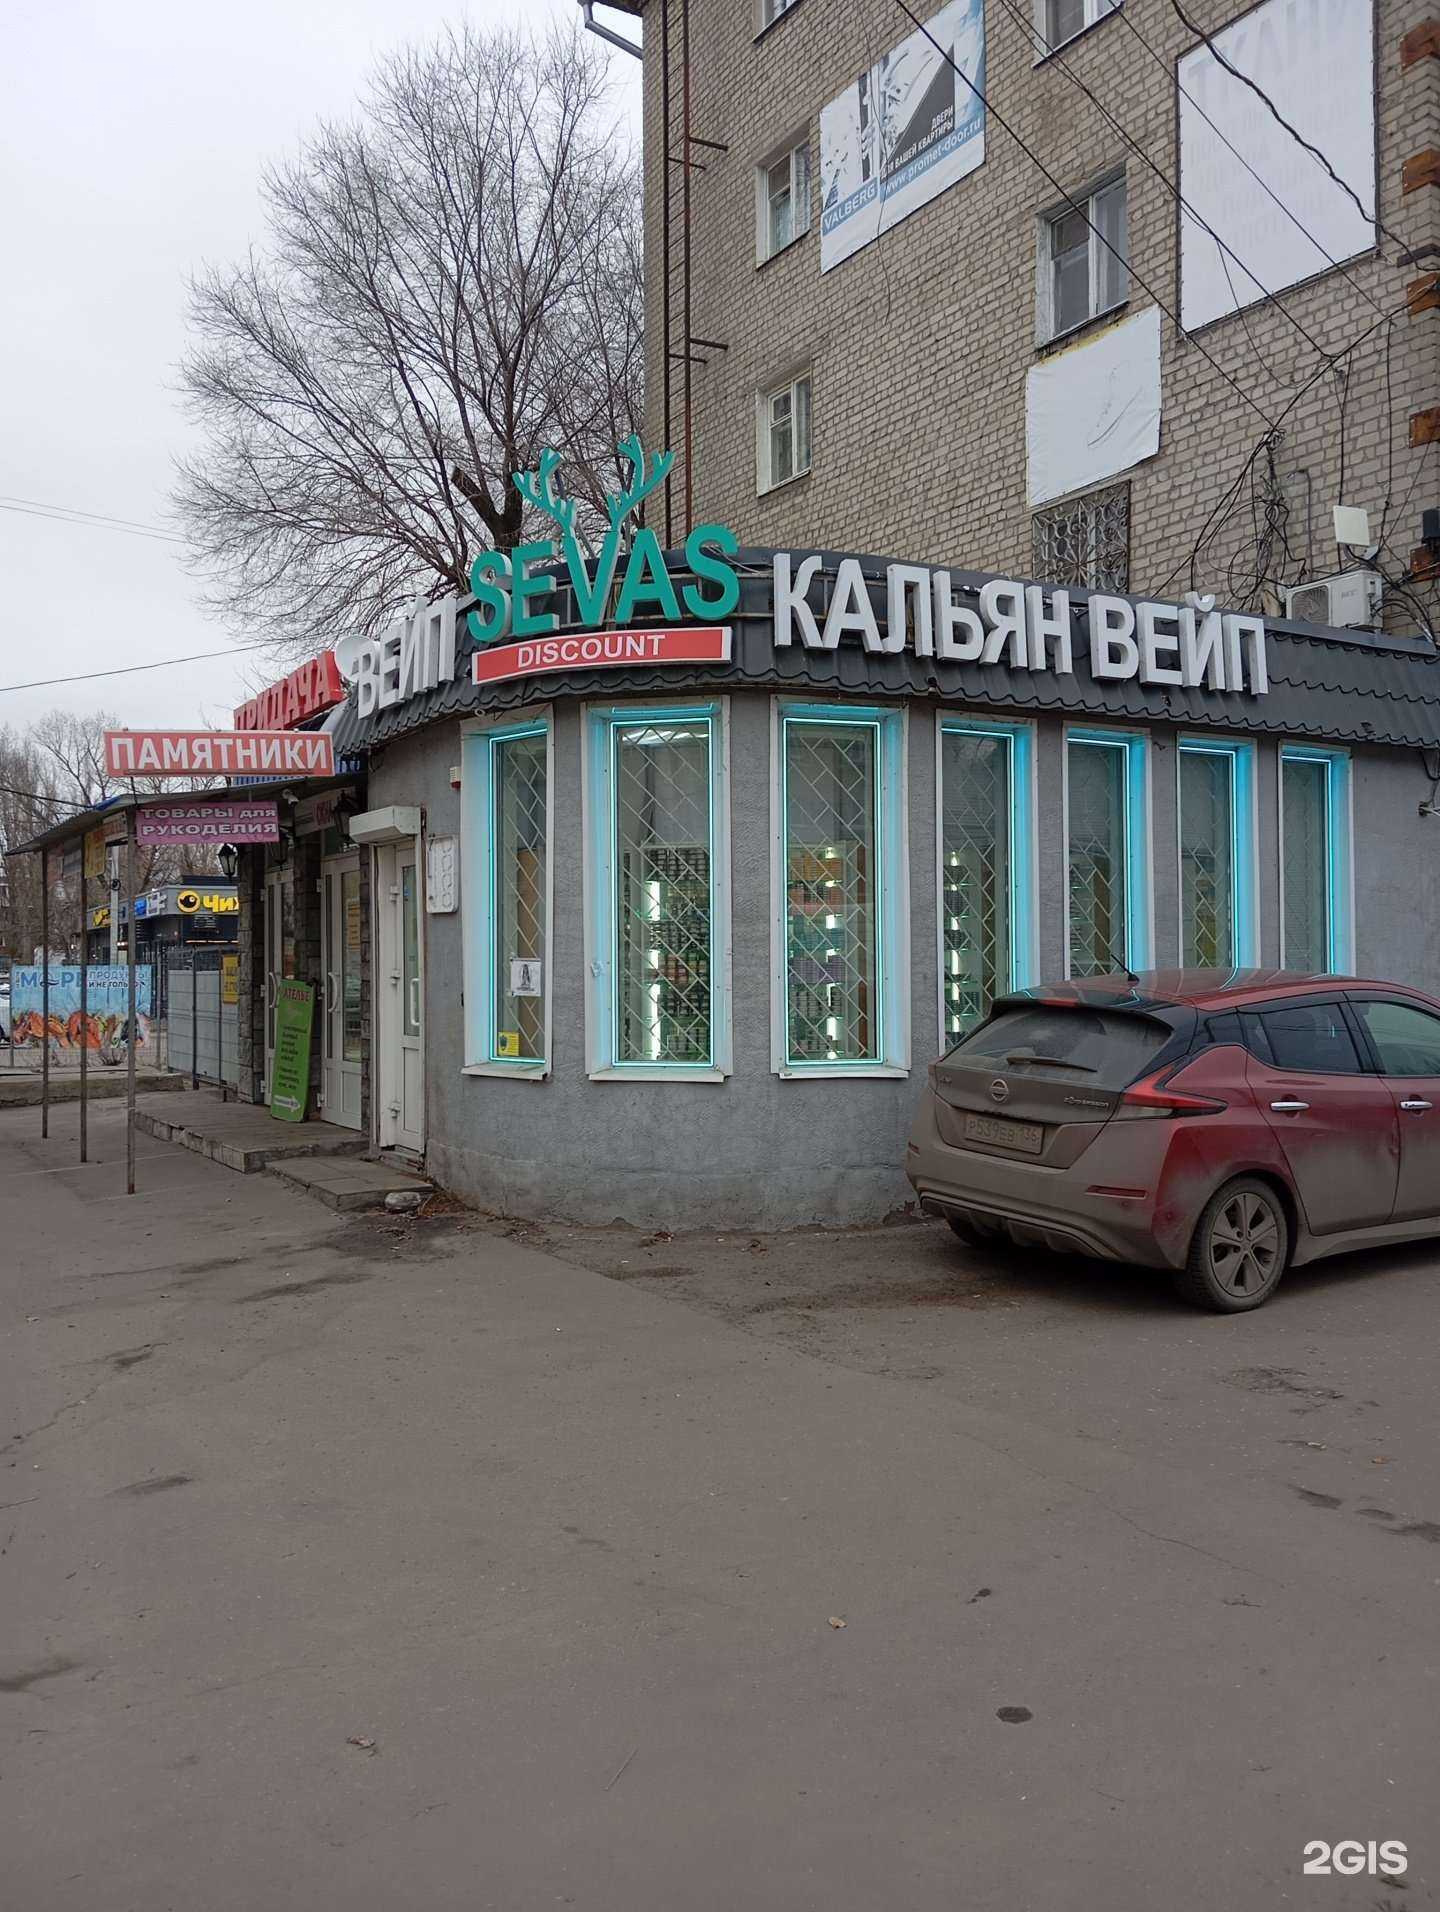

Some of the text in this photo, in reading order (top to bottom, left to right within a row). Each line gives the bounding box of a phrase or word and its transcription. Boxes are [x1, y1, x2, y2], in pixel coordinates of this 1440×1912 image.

[918, 117, 953, 152] КВАРТИРЫ
[932, 105, 953, 130] ДВЕРИ
[824, 185, 875, 229] VALBERG
[467, 520, 741, 643] SEVAS
[773, 552, 1269, 695] КАЛЬЯН ВЕЙП
[356, 593, 456, 719] ВЕЙП
[517, 633, 666, 669] DISCOUNT
[111, 737, 328, 770] ПАМЯТНИКИ
[140, 807, 276, 820] ТОВАРЫ для
[141, 822, 277, 836] РУКОДЕЛИЯ
